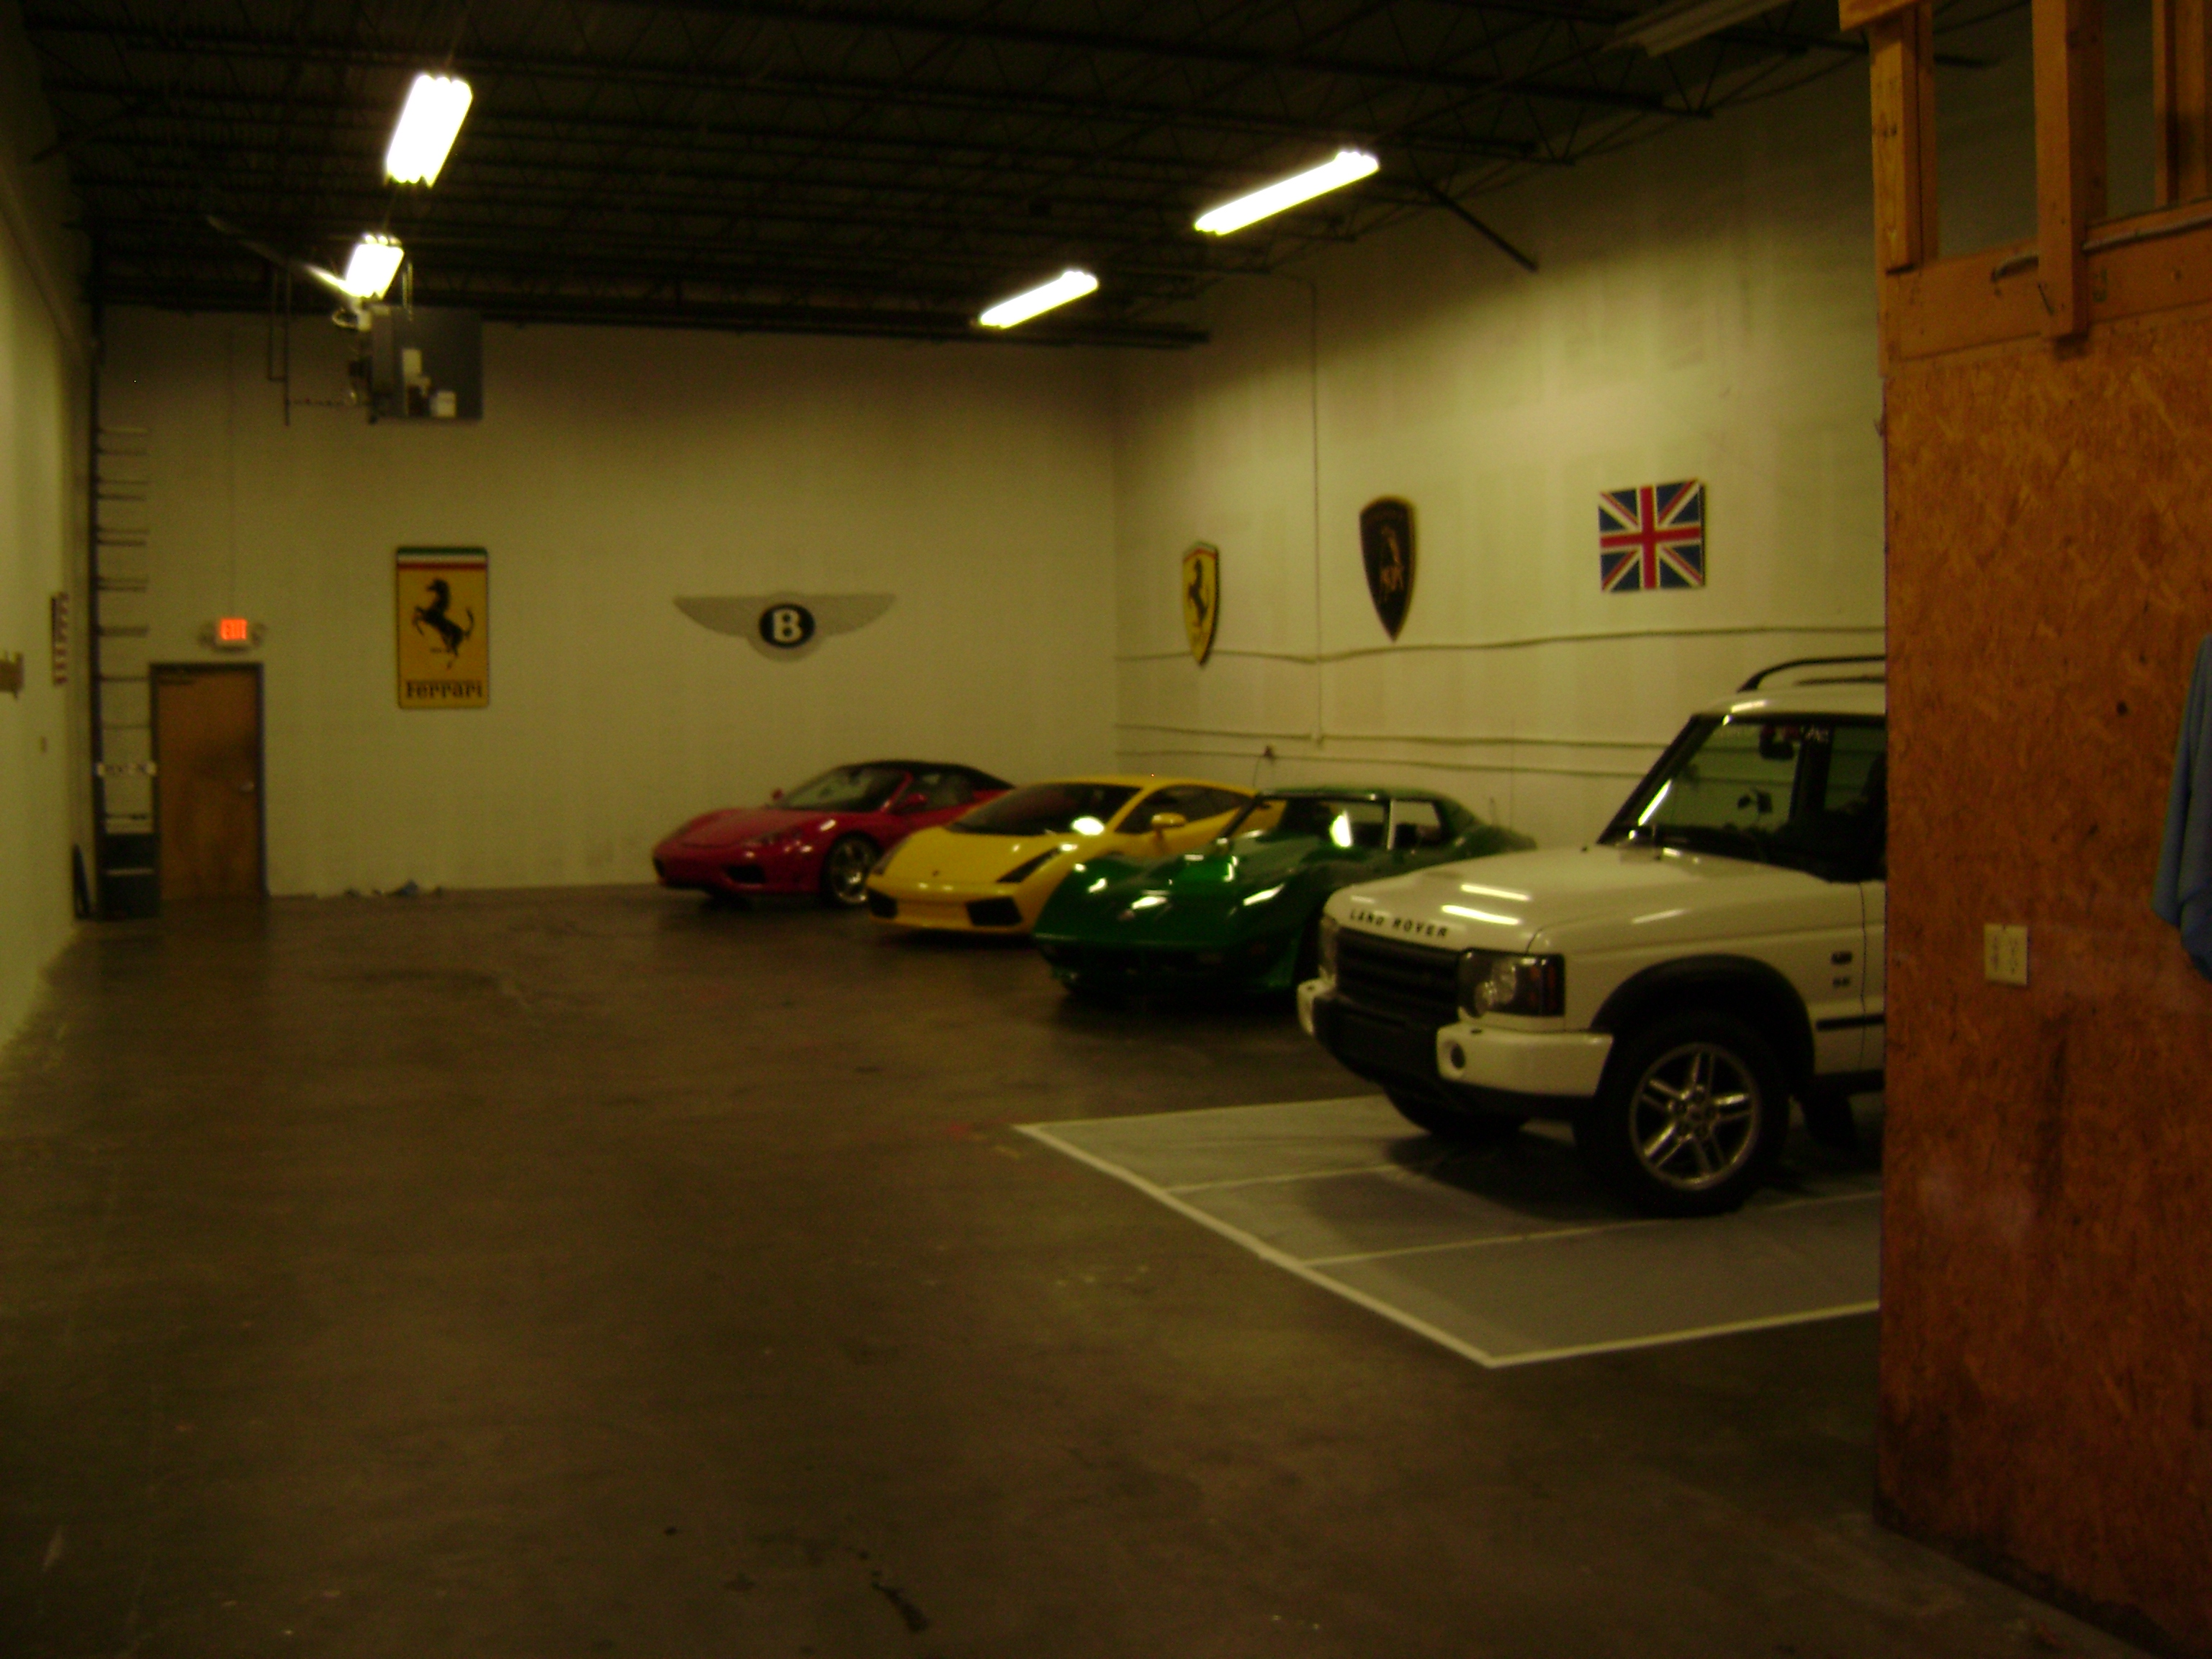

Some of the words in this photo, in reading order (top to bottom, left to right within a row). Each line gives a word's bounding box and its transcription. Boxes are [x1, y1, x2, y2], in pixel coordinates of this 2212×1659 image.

[772, 609, 803, 643] B
[406, 680, 483, 698] Ferrari
[1349, 909, 1385, 926] LAND
[1393, 917, 1447, 937] ROVER
